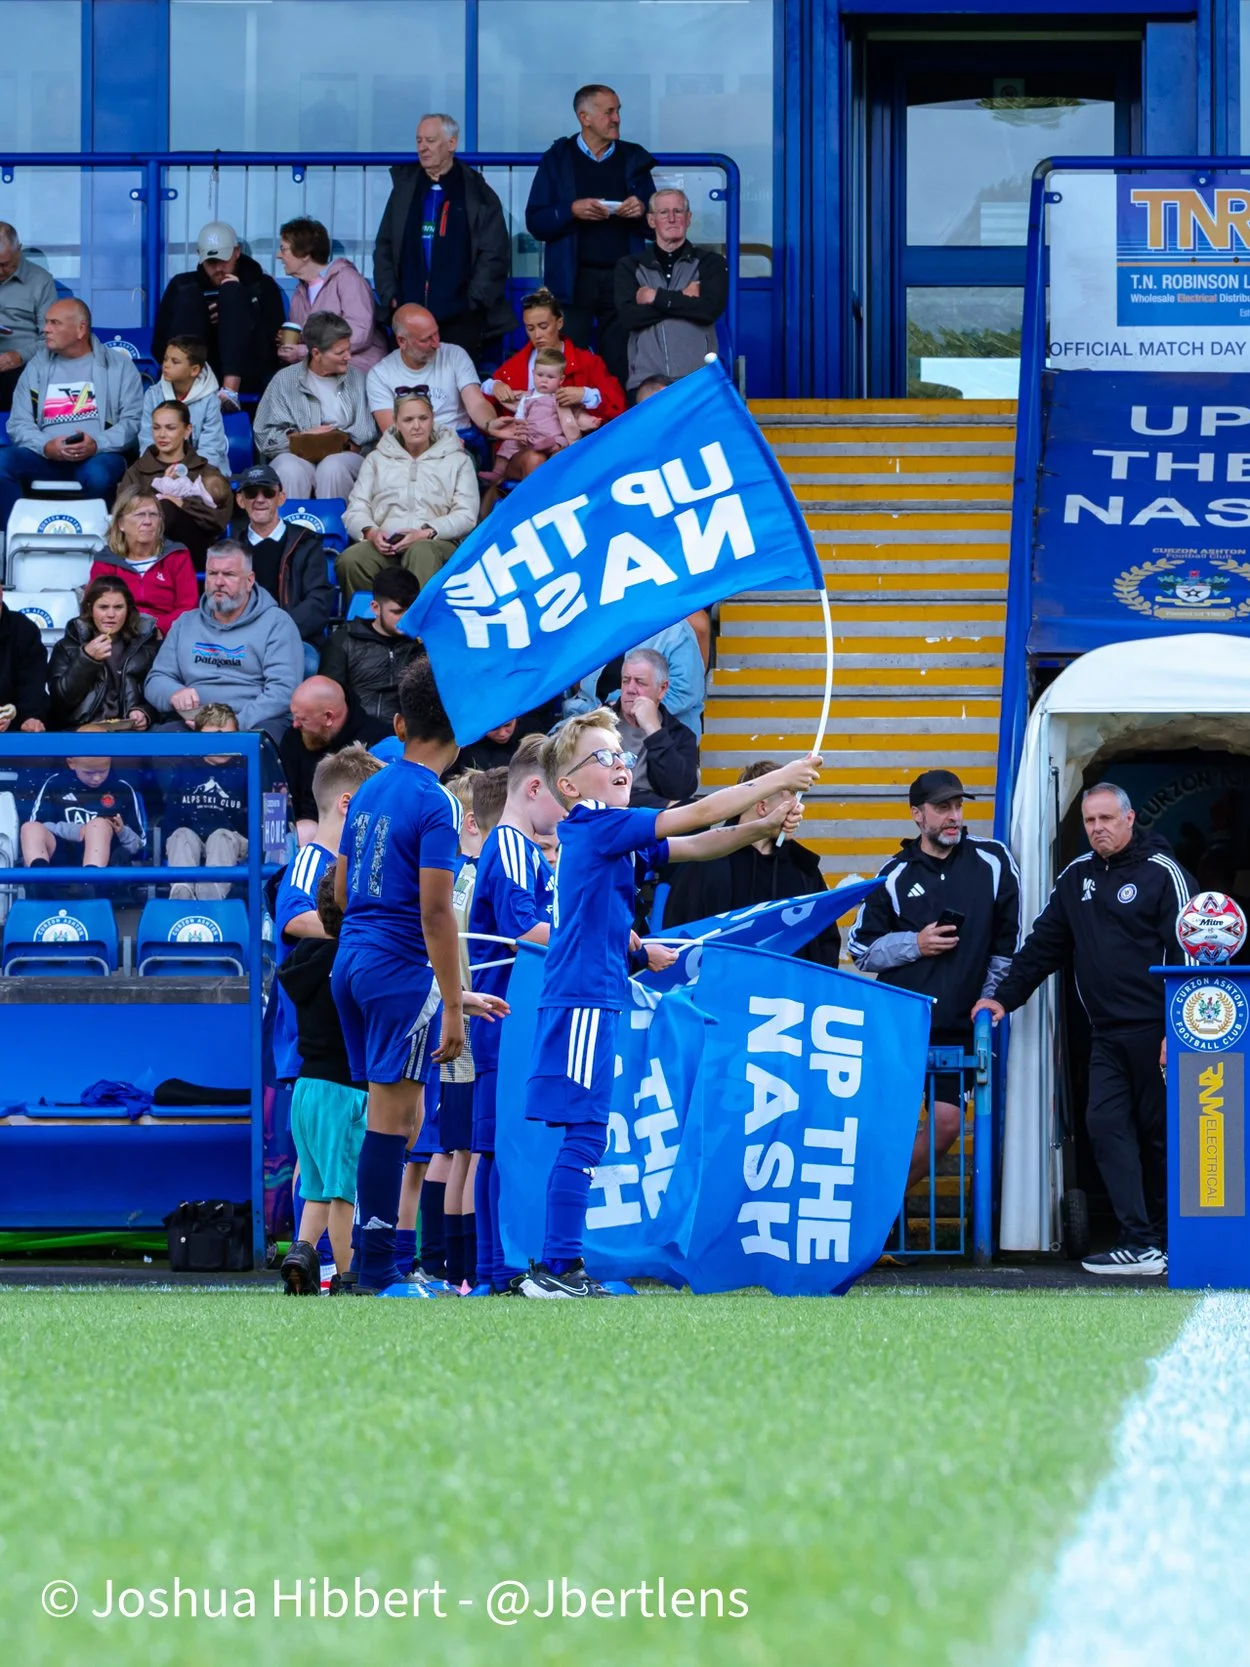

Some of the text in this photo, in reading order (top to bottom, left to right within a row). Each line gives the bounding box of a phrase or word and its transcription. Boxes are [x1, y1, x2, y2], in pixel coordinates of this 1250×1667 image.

[1131, 274, 1157, 289] T.N.
[1162, 274, 1239, 289] ROBINSON
[1131, 293, 1175, 303] Wholesale
[1177, 293, 1217, 303] Electrical
[1239, 308, 1250, 317] Est
[1050, 341, 1134, 357] OFFICIAL
[1139, 341, 1205, 356] MATCH
[1210, 341, 1248, 356] DAY
[194, 655, 242, 668] patagonia
[182, 795, 200, 804] ALPS
[220, 798, 241, 809] CLUB
[265, 820, 285, 844] HOME
[1176, 977, 1244, 1008] CURZON ASHTON
[1176, 1022, 1242, 1050] FOOTBALL CLUB
[737, 996, 804, 1262] NASH
[797, 1004, 864, 1264] UP THE
[1206, 1119, 1218, 1204] ELECTRICAL
